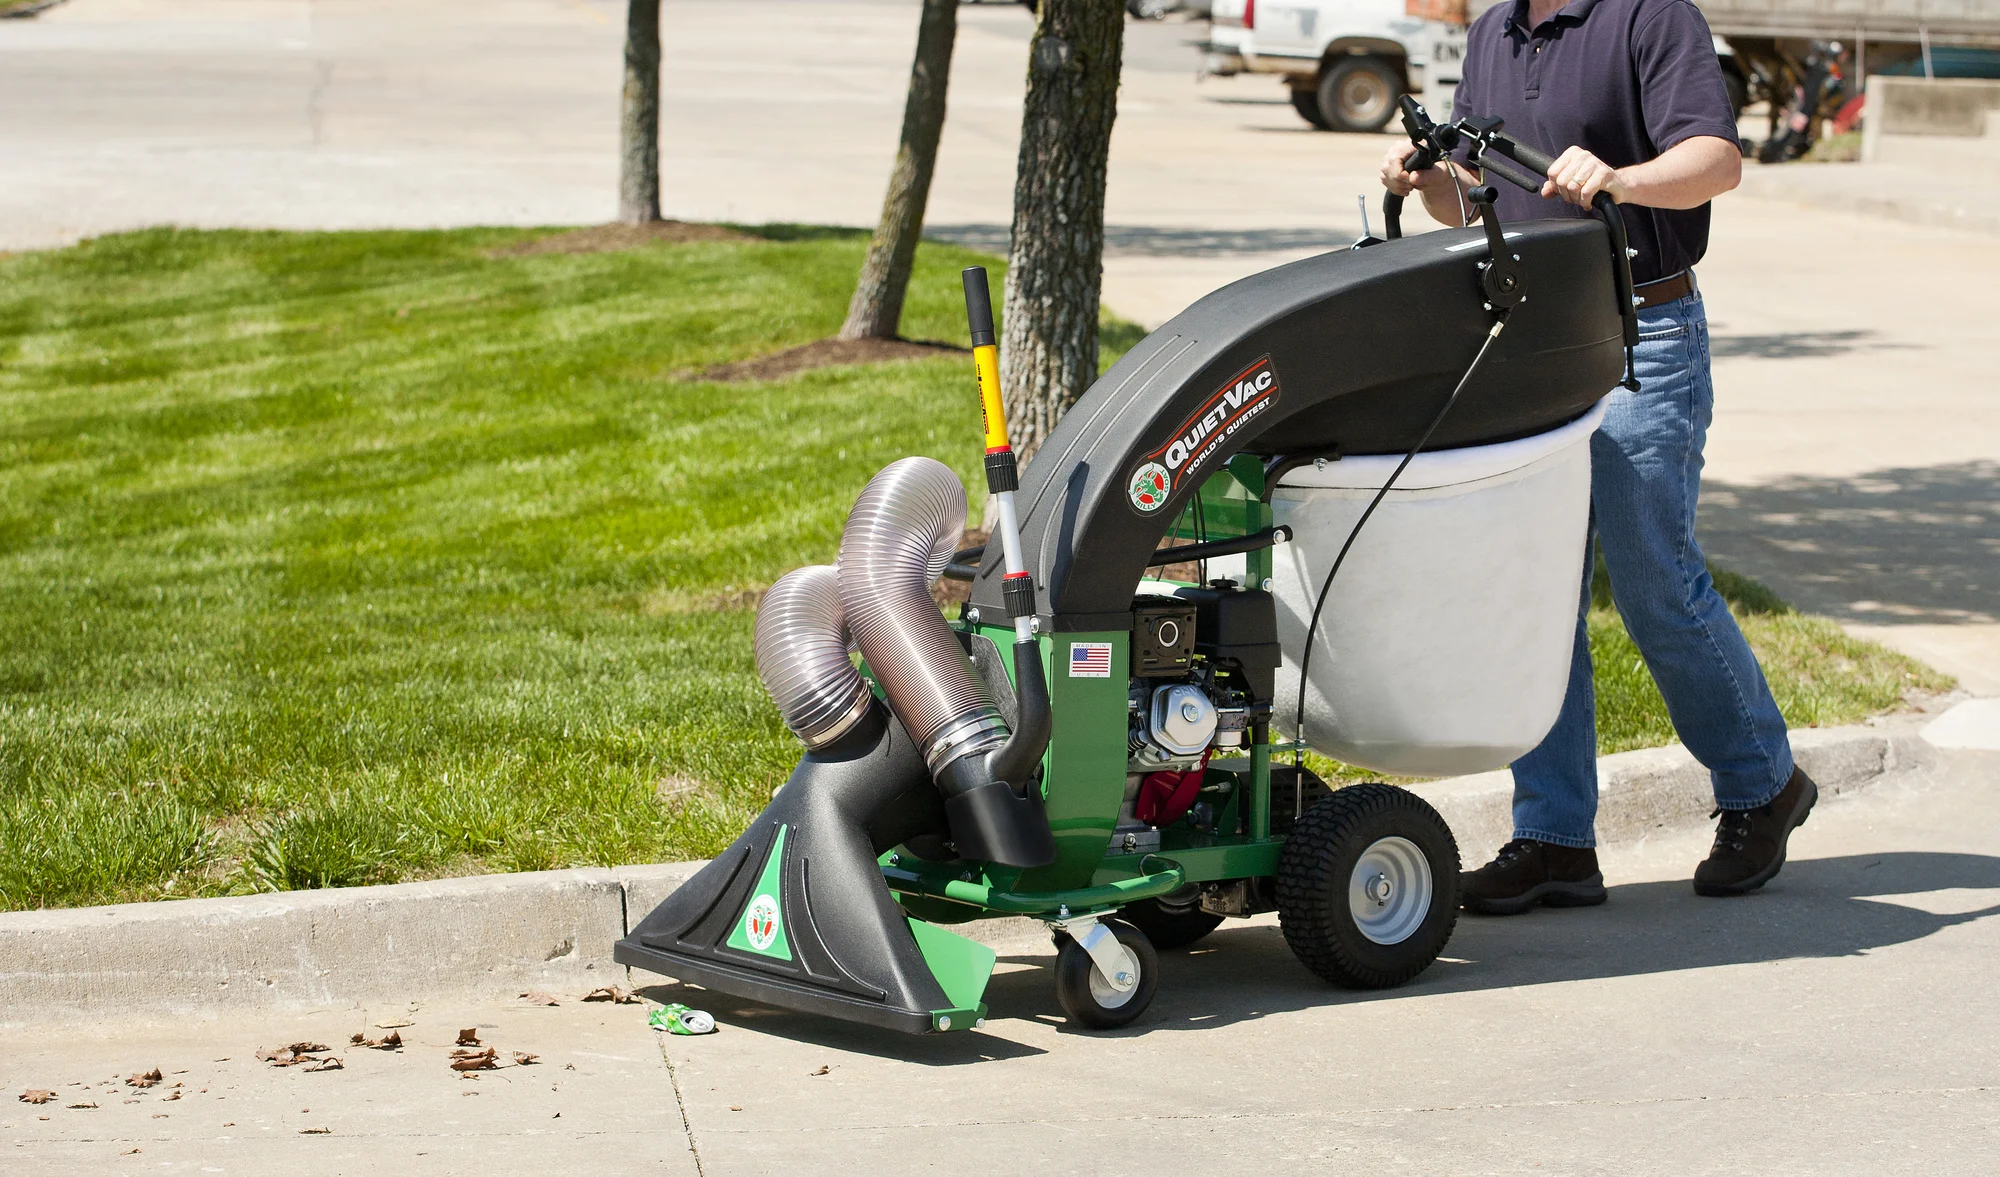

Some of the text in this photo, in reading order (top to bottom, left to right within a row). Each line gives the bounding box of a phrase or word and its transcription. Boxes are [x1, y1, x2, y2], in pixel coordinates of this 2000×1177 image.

[1186, 397, 1270, 475] WORLD'S QUIETEST
[1135, 469, 1169, 510] BILLY GOAT
